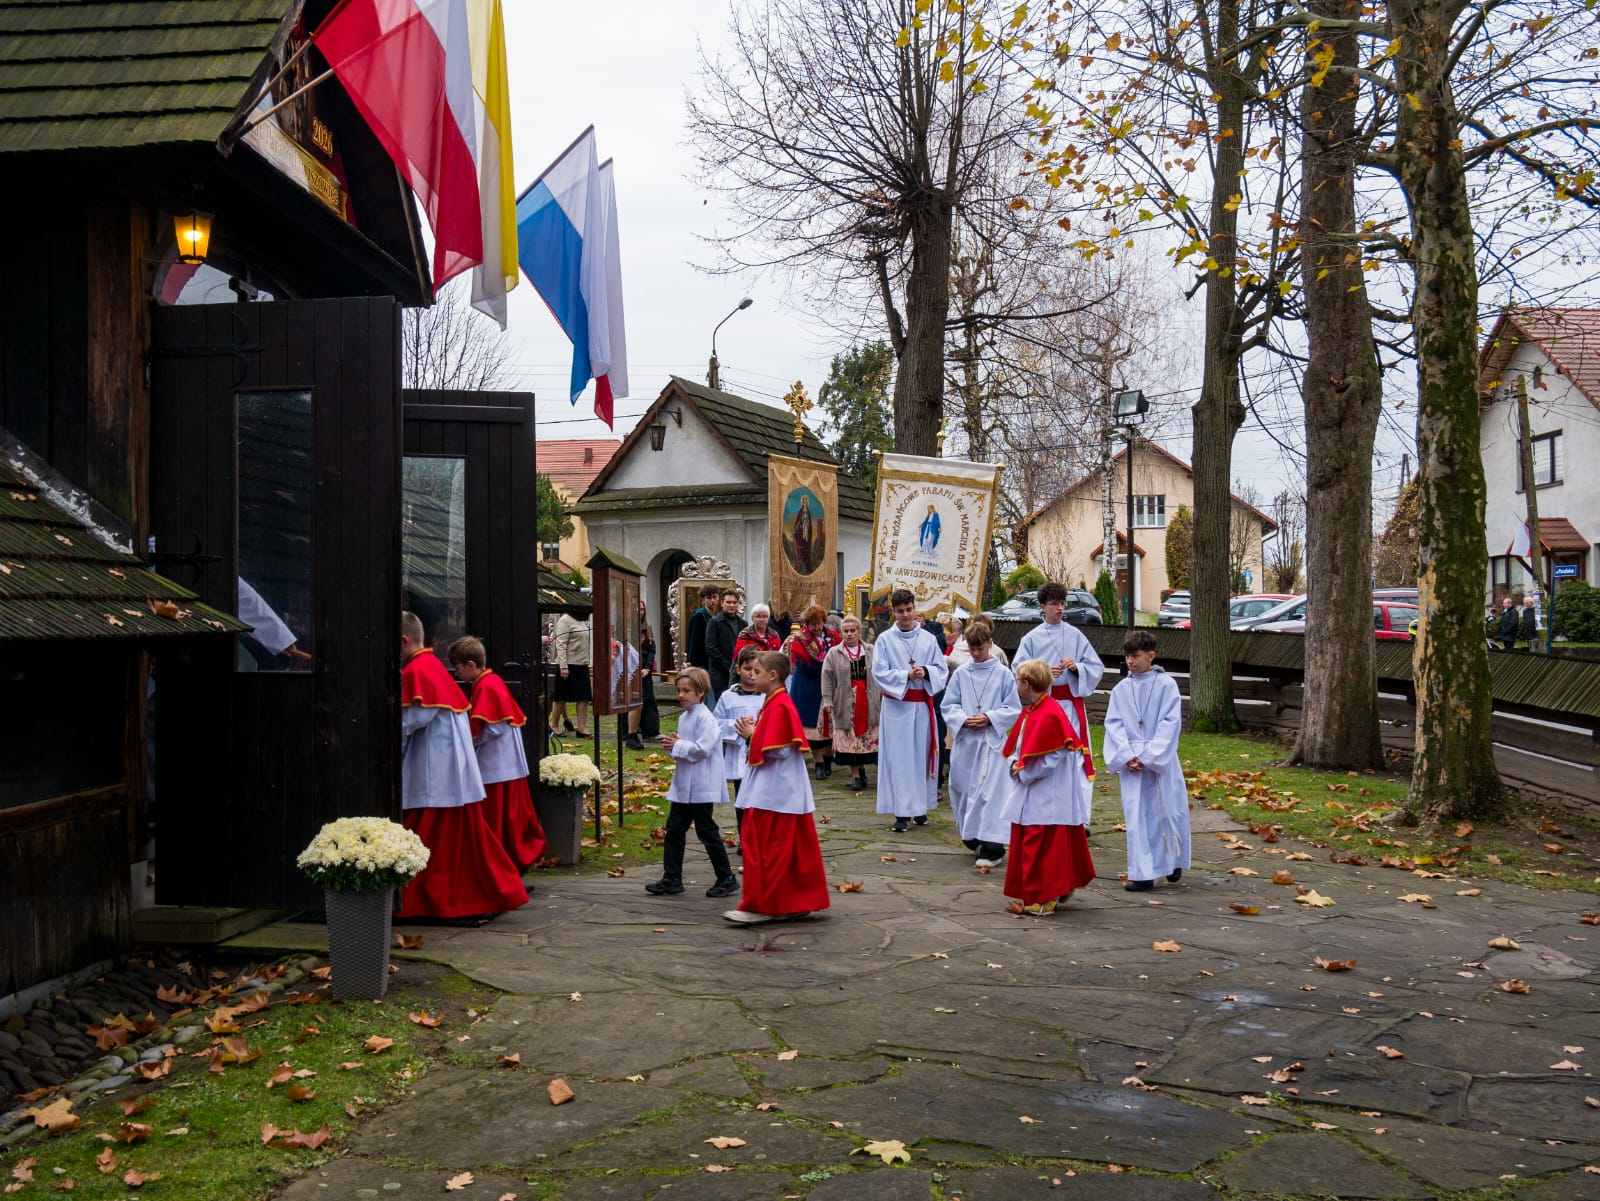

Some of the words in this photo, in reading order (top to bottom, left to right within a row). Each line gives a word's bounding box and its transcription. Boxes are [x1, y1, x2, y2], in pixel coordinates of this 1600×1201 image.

[312, 116, 333, 158] 2026
[922, 487, 954, 500] PARAFII
[892, 490, 919, 536] RÓŻAŃCOWE
[954, 498, 965, 512] ŚW.
[959, 513, 970, 552] MARCINA
[889, 540, 898, 561] RÓŻE
[957, 554, 965, 569] BPA
[894, 567, 965, 583] JAWISZOWICACH
